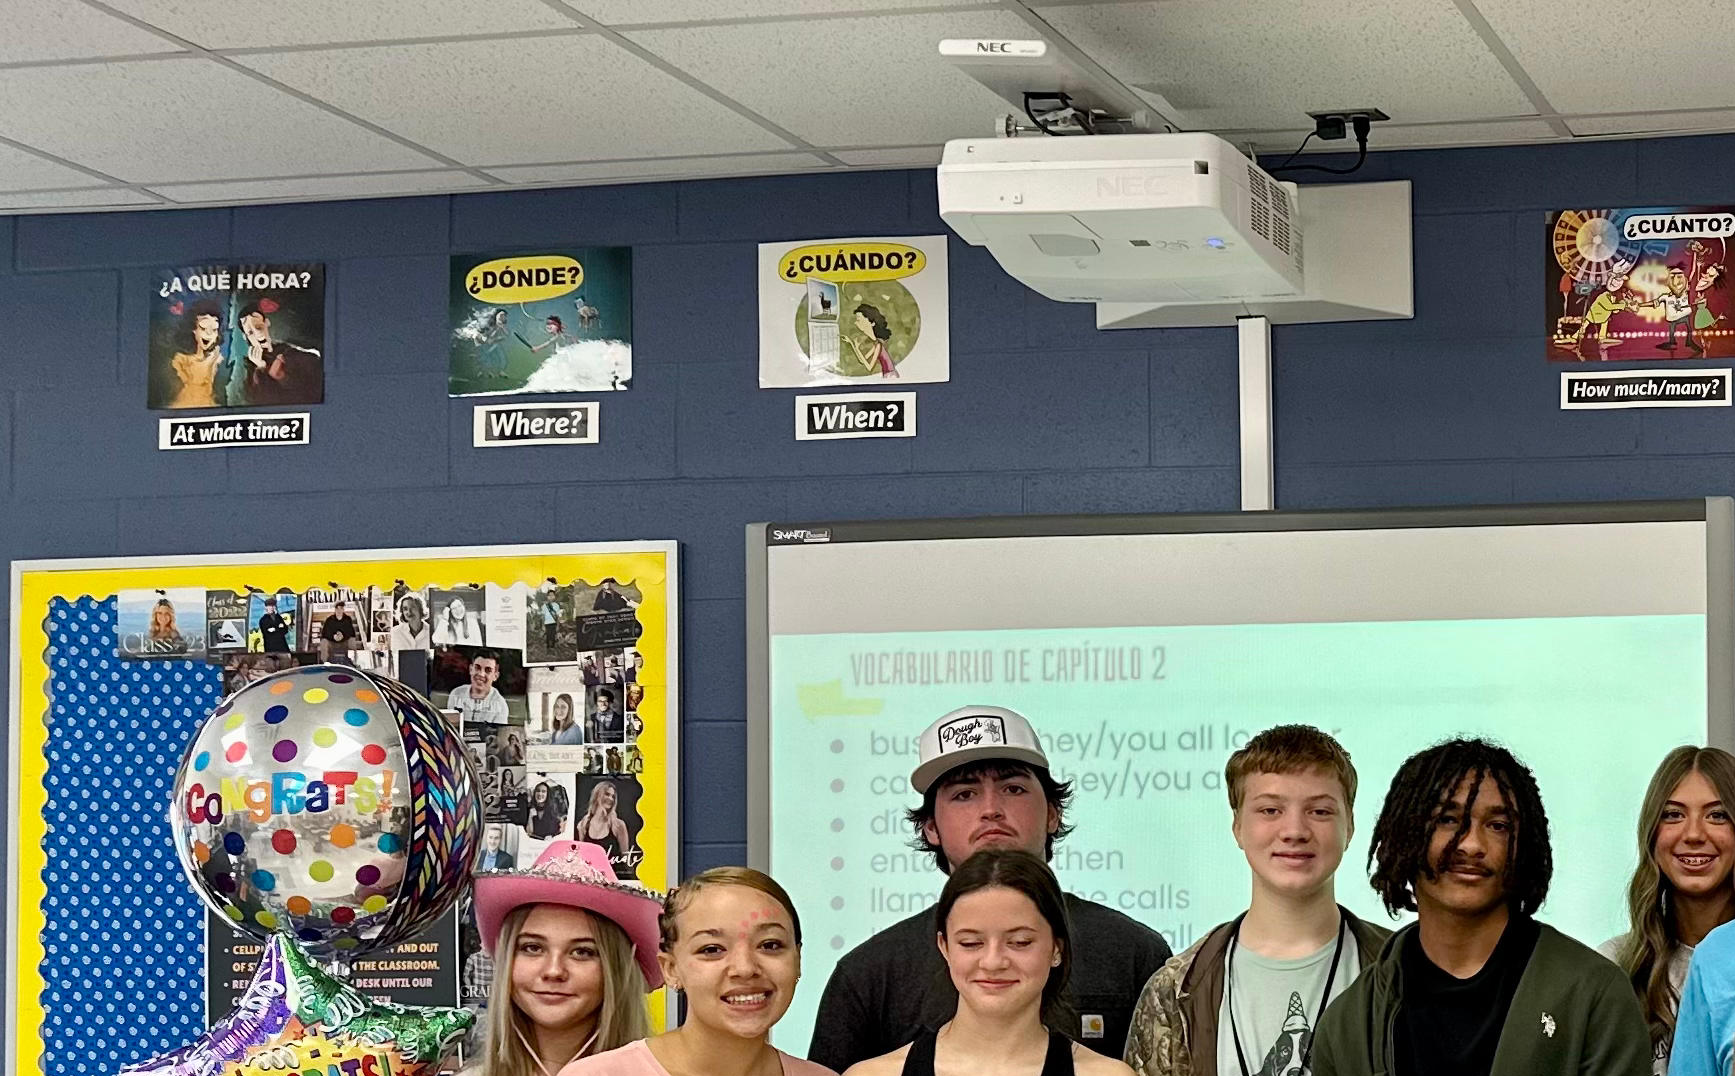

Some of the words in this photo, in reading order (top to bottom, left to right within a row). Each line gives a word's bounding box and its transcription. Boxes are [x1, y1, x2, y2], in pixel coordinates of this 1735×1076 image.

[977, 42, 1012, 53] NEC
[1096, 175, 1168, 197] NEC
[1627, 217, 1733, 238] ¿CUÁNTO?
[784, 249, 917, 279] ¿CUÁNDO?
[160, 274, 182, 297] ¿A
[187, 270, 230, 293] QUÉ
[237, 271, 311, 292] HORA?
[468, 265, 580, 294] ¿DÓNDE?
[1572, 381, 1610, 399] How
[1614, 378, 1720, 399] much/many?
[490, 410, 581, 436] Where?
[812, 404, 898, 429] When?
[173, 420, 194, 443] At
[199, 420, 243, 442] what
[248, 418, 300, 441] time?
[773, 530, 805, 540] SMART
[850, 647, 993, 687] VOCABULARIO
[1003, 651, 1031, 683] DE
[1042, 639, 1142, 684] CAPÍTULO
[1152, 646, 1166, 681] 2
[943, 719, 982, 742] Dough
[956, 732, 983, 748] Boy
[1177, 724, 1212, 752] all
[1054, 846, 1124, 871] then
[1118, 884, 1190, 910] calls
[397, 944, 418, 953] AND
[419, 943, 439, 953] OUT
[232, 962, 247, 972] OF
[359, 961, 377, 970] THE
[378, 960, 440, 970] CLASSROOM.
[356, 979, 381, 988] DESK
[382, 978, 411, 988] UNTIL
[412, 978, 432, 987] OUR
